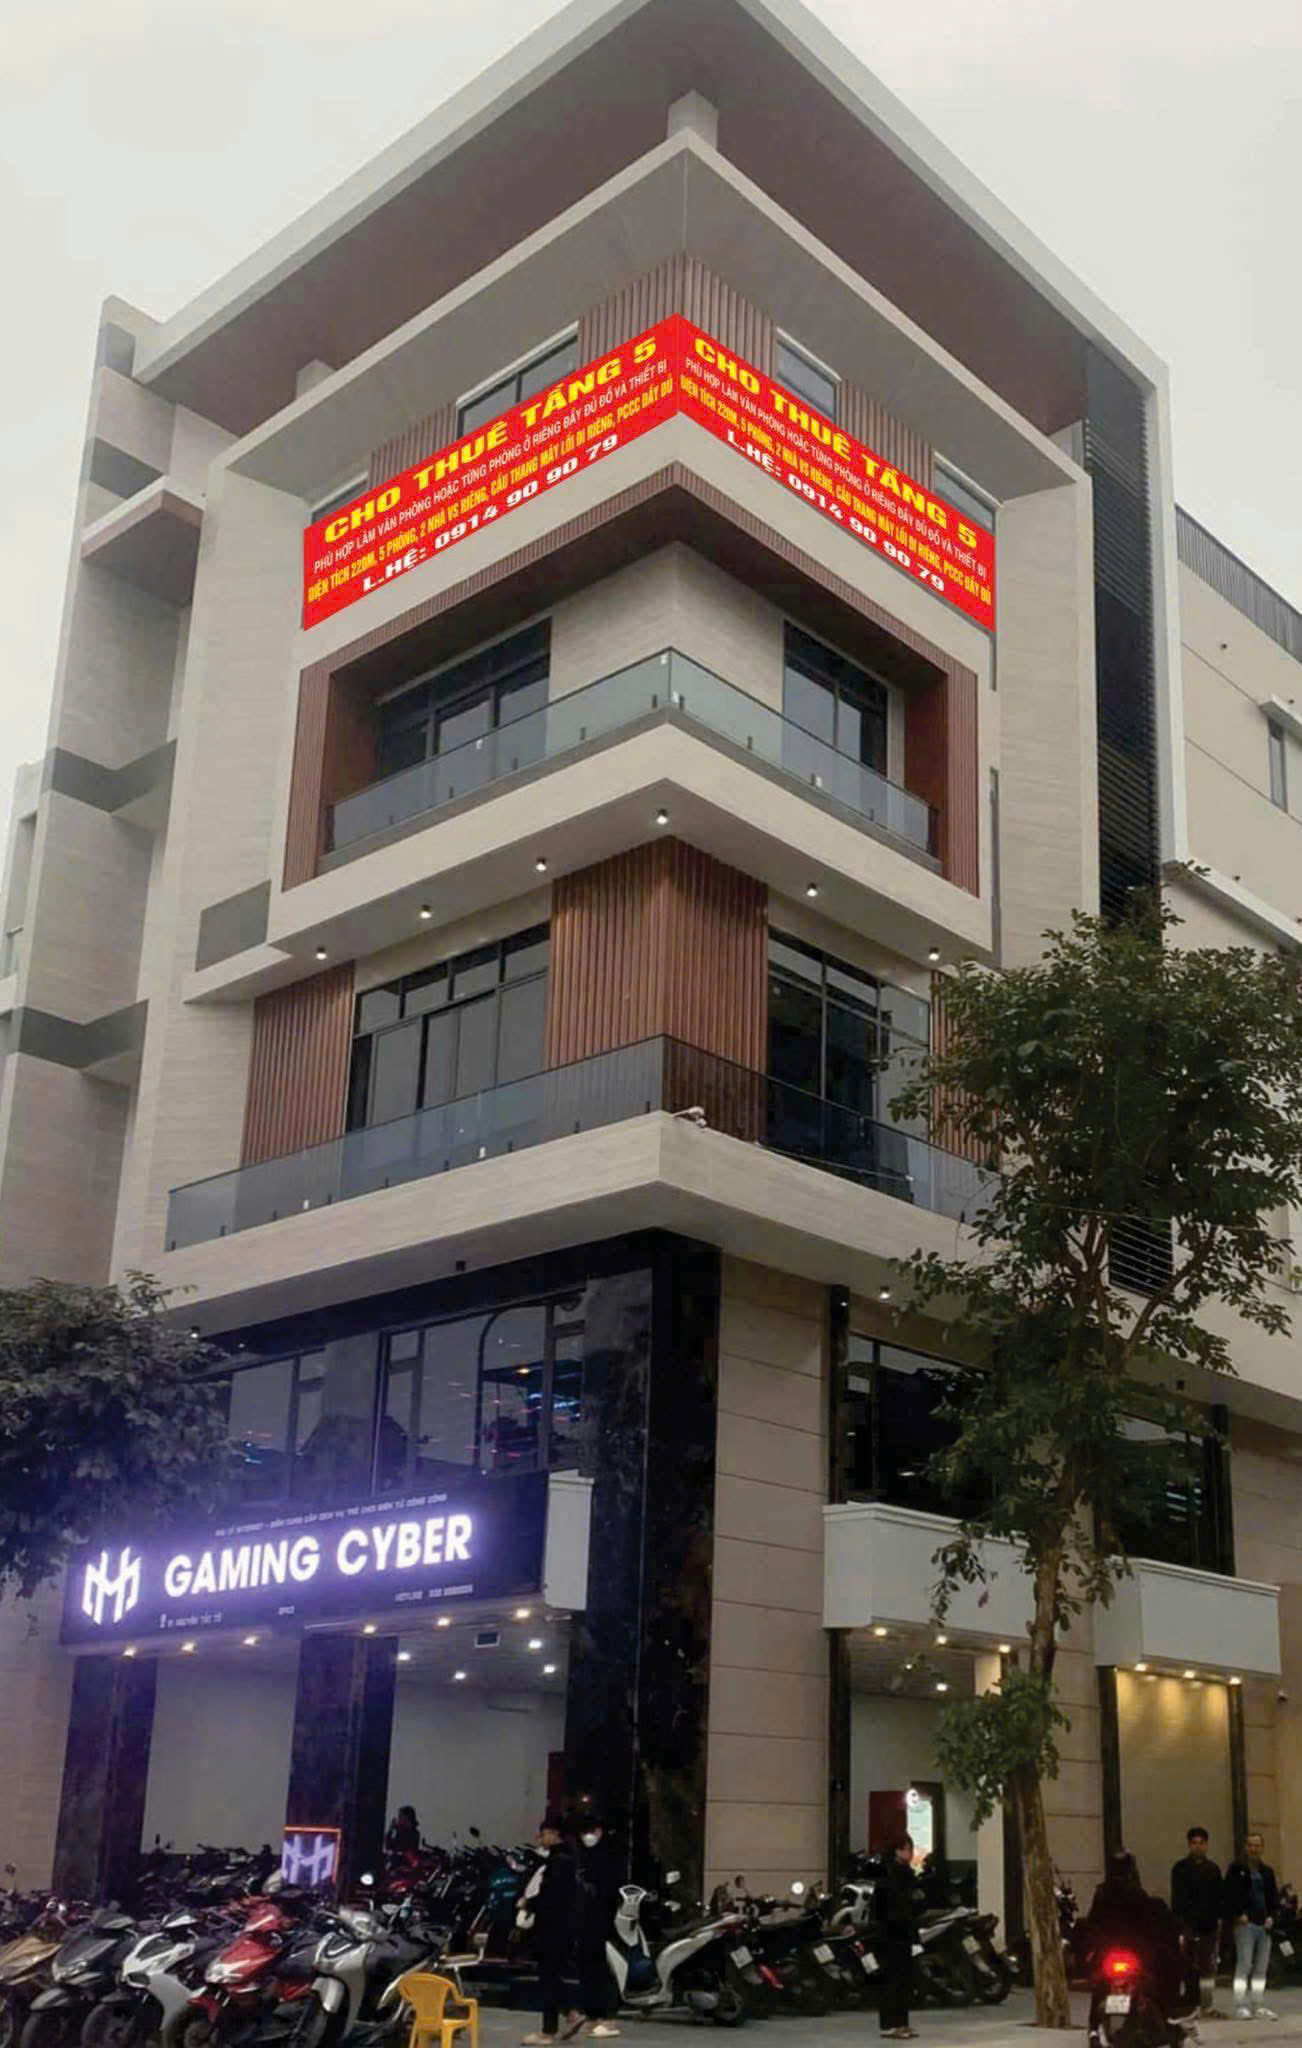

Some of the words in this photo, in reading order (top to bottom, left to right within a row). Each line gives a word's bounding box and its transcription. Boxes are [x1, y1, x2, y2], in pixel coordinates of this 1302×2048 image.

[685, 356, 703, 377] PHÙ
[314, 551, 333, 573] PHÙ
[356, 528, 376, 549] LÀM
[378, 515, 397, 537] VĂN
[399, 496, 431, 525] PHÒNG
[489, 443, 521, 472] PHÒNG
[532, 420, 561, 447] RIÊNG
[615, 379, 627, 398] VÀ
[325, 486, 400, 543] CHO
[412, 420, 508, 490] THUÊ
[634, 336, 656, 364] 5
[378, 546, 385, 561] 5
[419, 520, 426, 537] 2
[427, 508, 446, 533] NHÀ
[510, 456, 538, 483] THANG
[540, 442, 559, 468] MÁY
[617, 396, 641, 424] PCCC
[435, 505, 498, 549] 0914
[507, 480, 539, 507] 90
[546, 457, 578, 484] 90
[585, 433, 618, 461] 79
[695, 337, 760, 395] CHO
[770, 387, 851, 462] THUÊ
[957, 520, 977, 549] 5
[740, 417, 747, 433] 5
[775, 442, 781, 458] 2
[788, 472, 844, 520] 0914
[849, 516, 877, 544] 90
[882, 540, 911, 568] 90
[916, 562, 945, 592] 79
[164, 1535, 320, 1598] GAMING
[337, 1514, 473, 1576] CYBER
